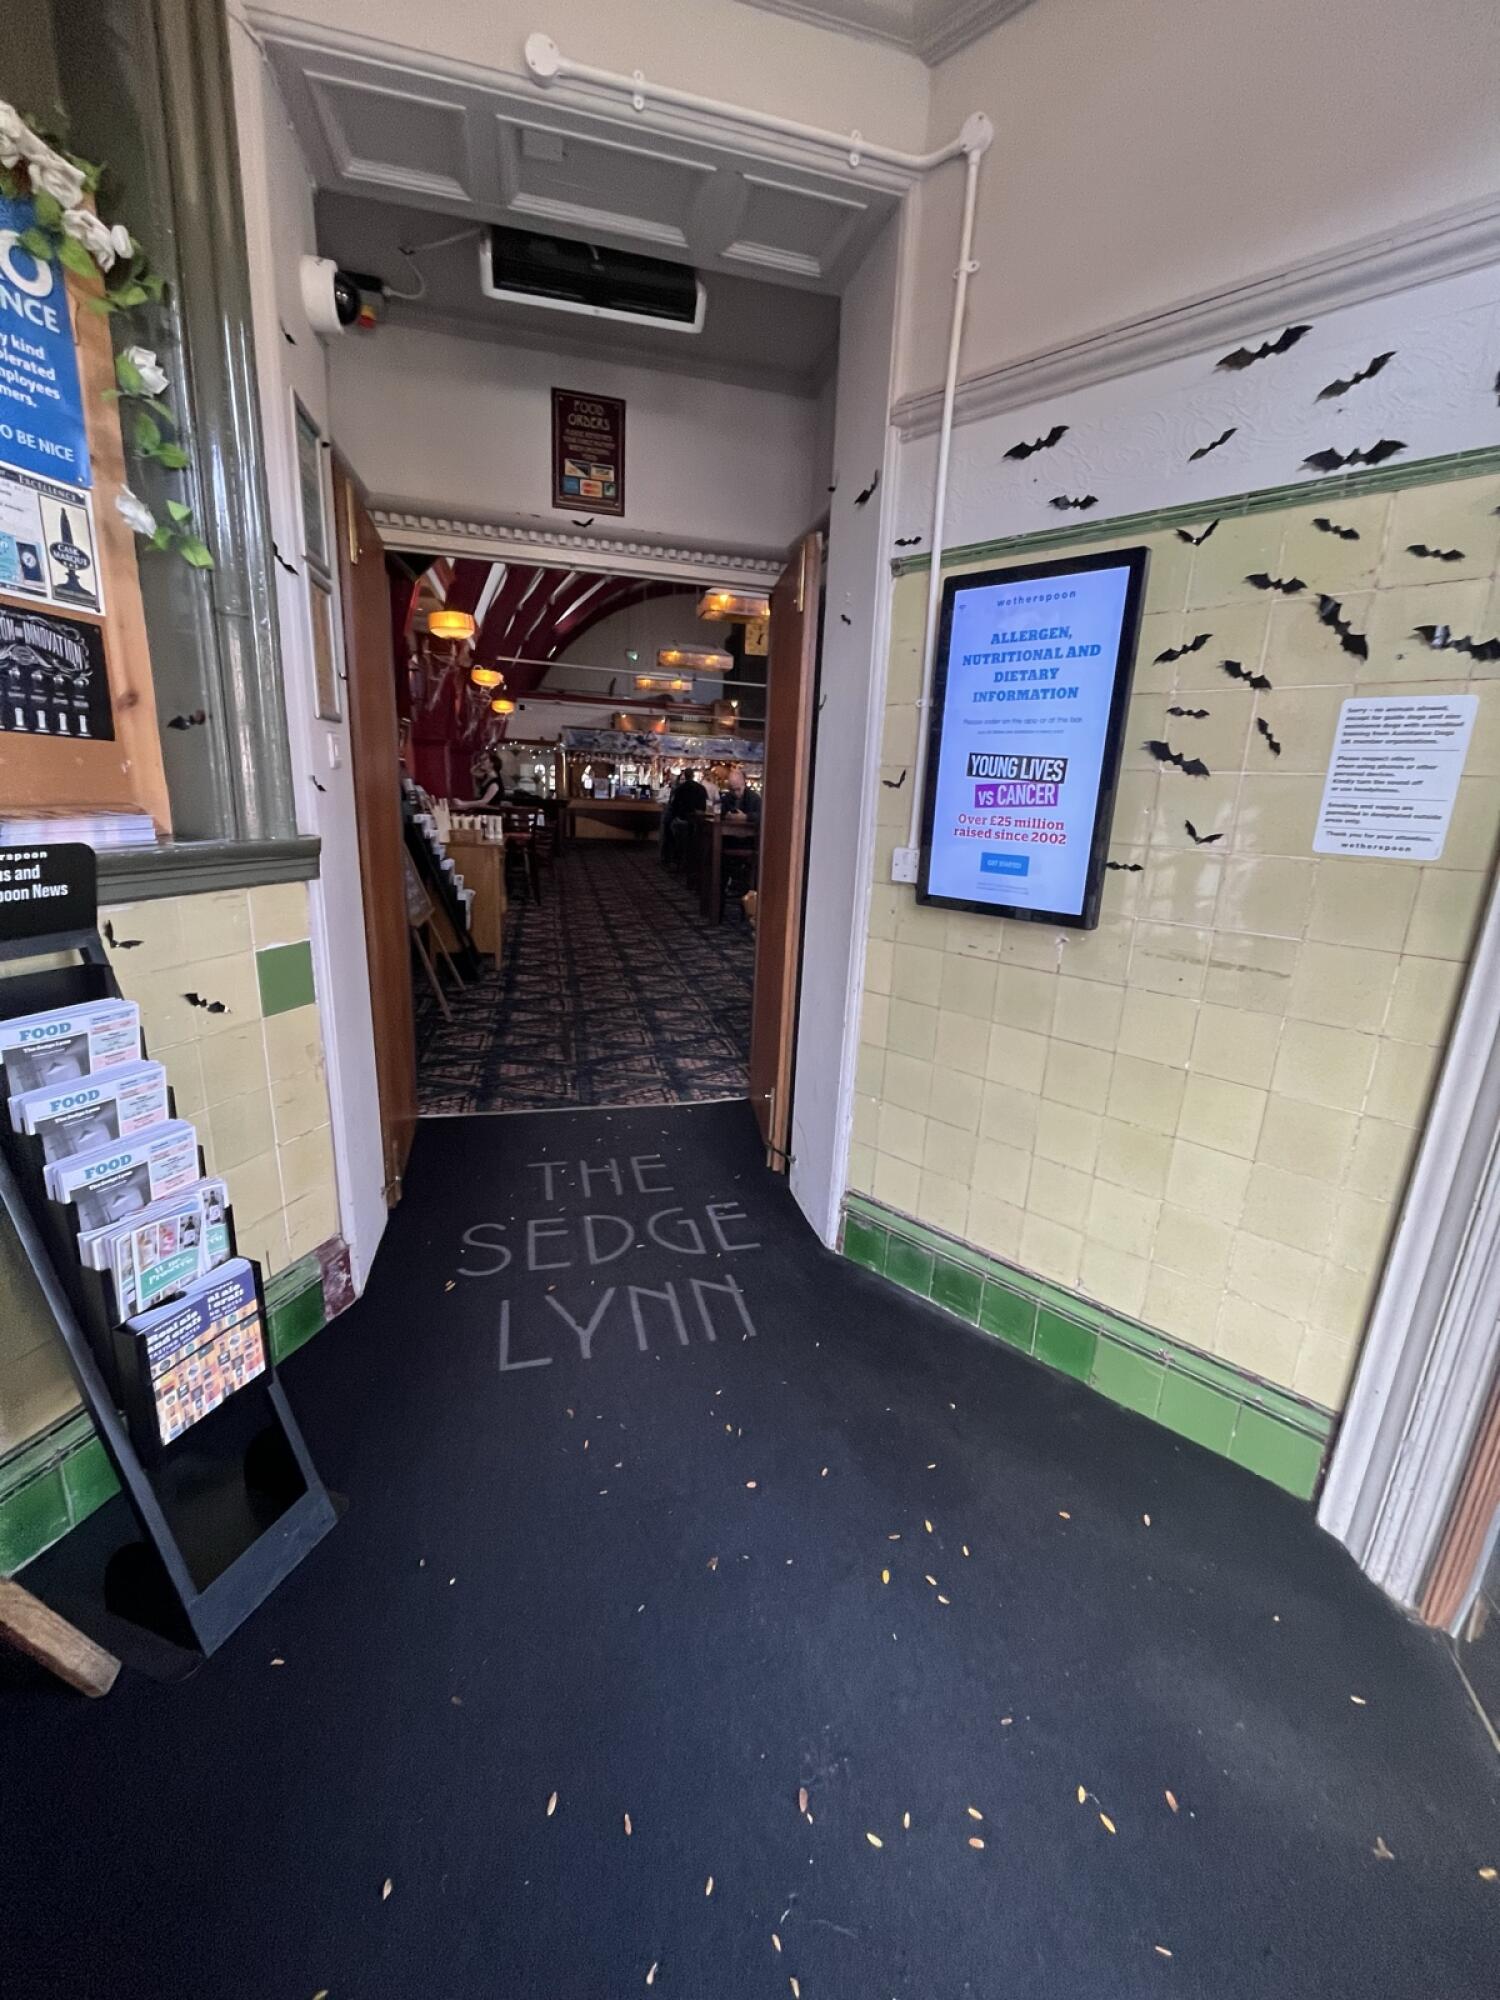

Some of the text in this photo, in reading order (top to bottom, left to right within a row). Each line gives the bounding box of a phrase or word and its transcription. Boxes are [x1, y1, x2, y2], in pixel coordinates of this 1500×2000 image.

[11, 334, 46, 360] kind
[15, 429, 37, 449] BE
[38, 438, 75, 462] NICE
[996, 590, 1077, 607] wetherspoon
[990, 625, 1073, 645] ALLERGEN,
[962, 643, 1102, 666] NUTRITIONAL AND
[993, 667, 1060, 683] DIETARY
[972, 686, 1079, 703] INFORMATION
[971, 754, 1065, 782] YOUNG LIVES
[996, 782, 1056, 806] CANCER
[958, 813, 1065, 832] Over £25 million
[953, 826, 1067, 846] raised since 2002
[1340, 842, 1413, 852] wetherspoon
[14, 864, 41, 881] and
[32, 883, 69, 899] News
[20, 1022, 72, 1041] FOOD
[50, 1089, 100, 1112] FOOD
[84, 1154, 132, 1180] FOOD
[527, 1153, 675, 1201] THE
[457, 1201, 762, 1277] SEDGE
[499, 1274, 756, 1373] LYNN
